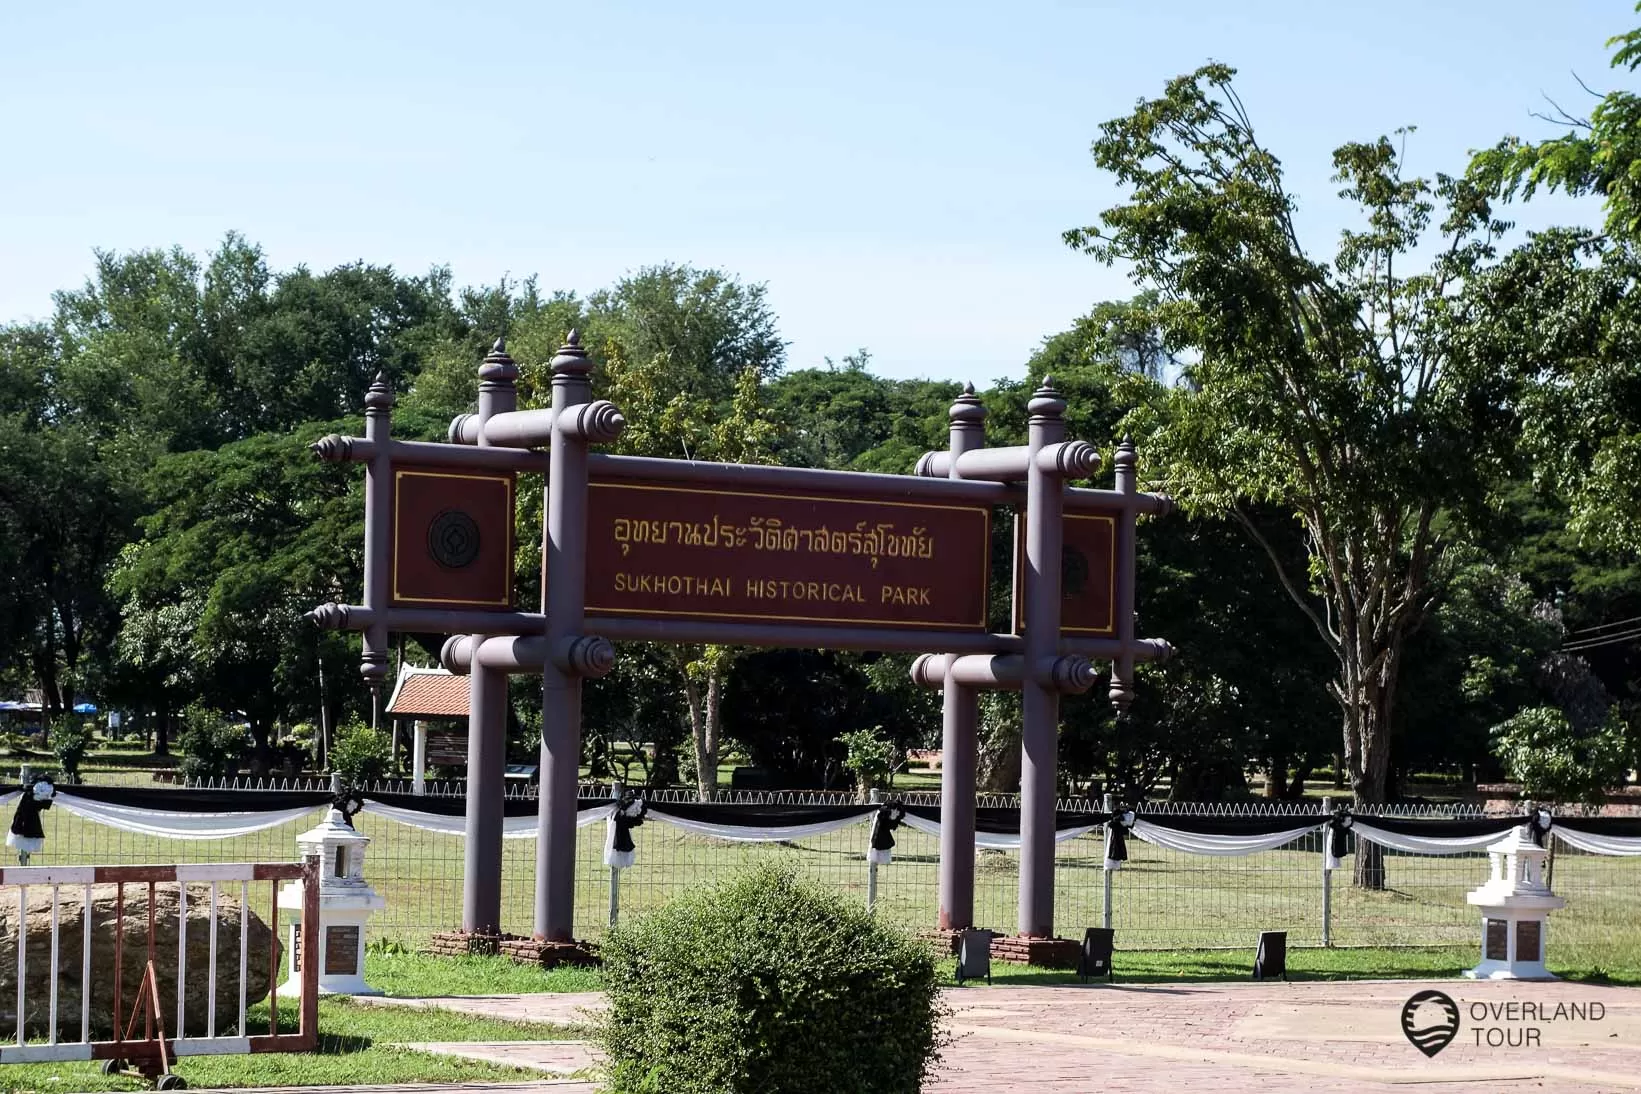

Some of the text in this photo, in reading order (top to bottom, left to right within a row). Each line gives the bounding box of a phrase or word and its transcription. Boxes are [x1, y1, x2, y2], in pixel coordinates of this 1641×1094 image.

[614, 515, 934, 569] อุทยานประวัติศาสตร์สุโขทัย
[614, 573, 931, 605] SUKHOTHAI HISTORICAL PARK
